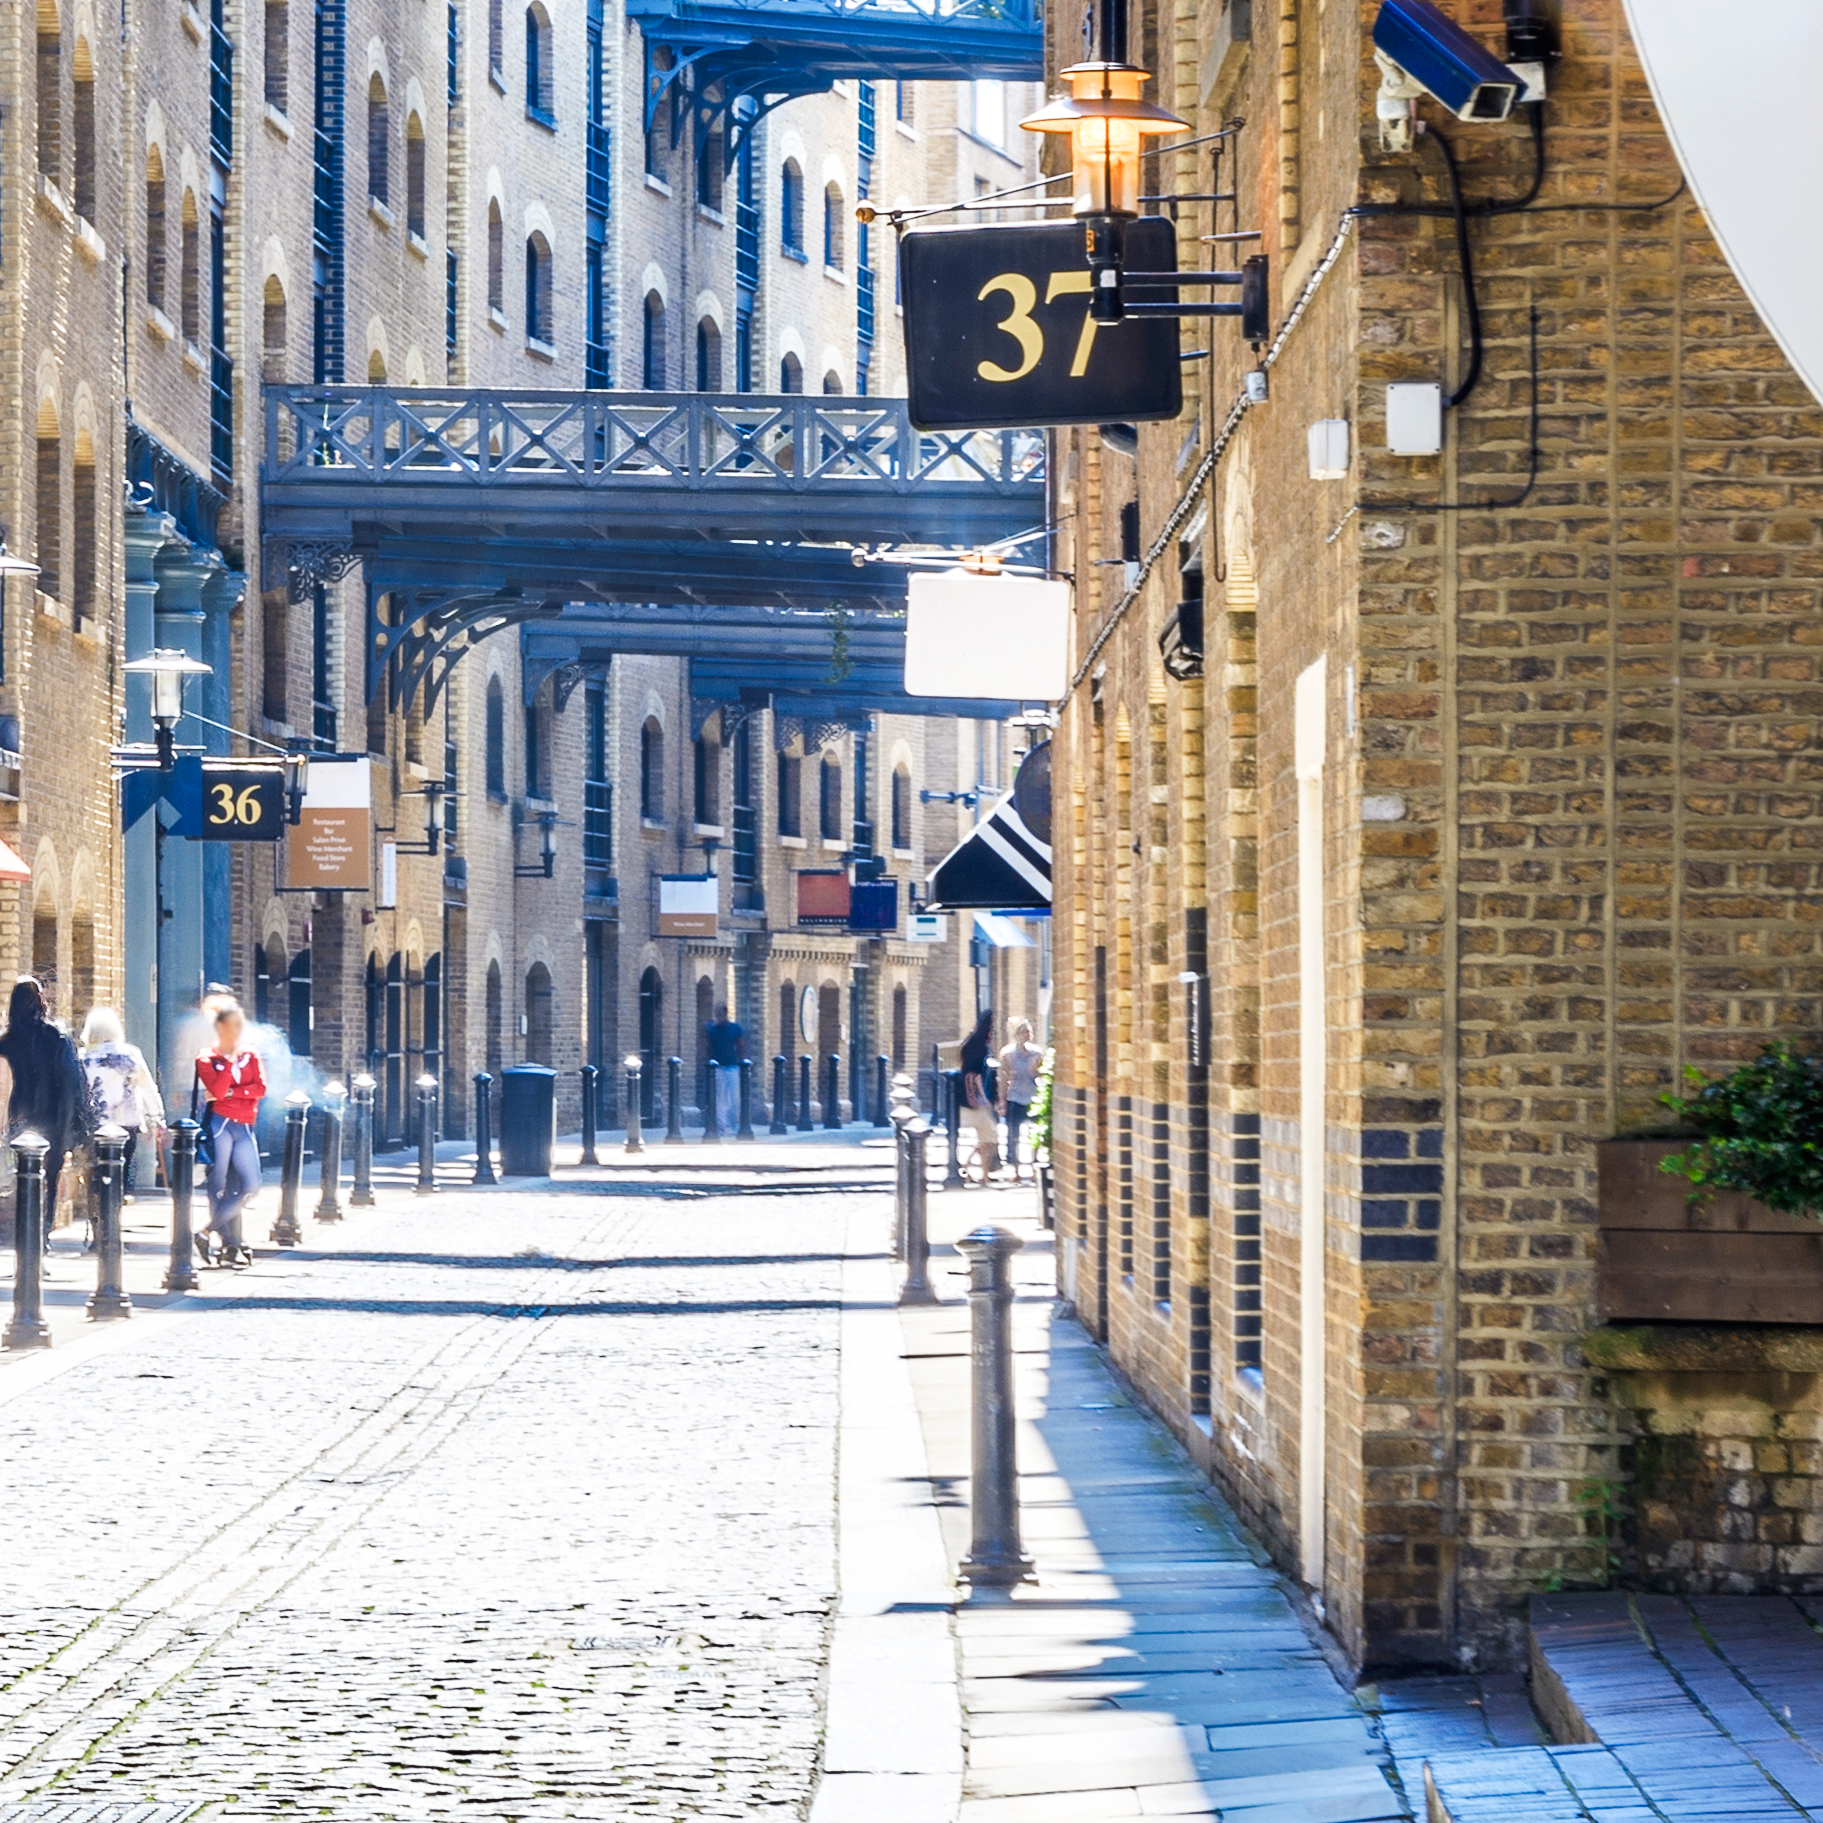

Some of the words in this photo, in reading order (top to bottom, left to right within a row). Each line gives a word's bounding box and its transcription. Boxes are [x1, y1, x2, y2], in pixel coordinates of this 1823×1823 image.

[977, 271, 1100, 382] 37
[209, 783, 262, 825] 36
[318, 863, 341, 872] Bakery
[329, 854, 346, 862] Store
